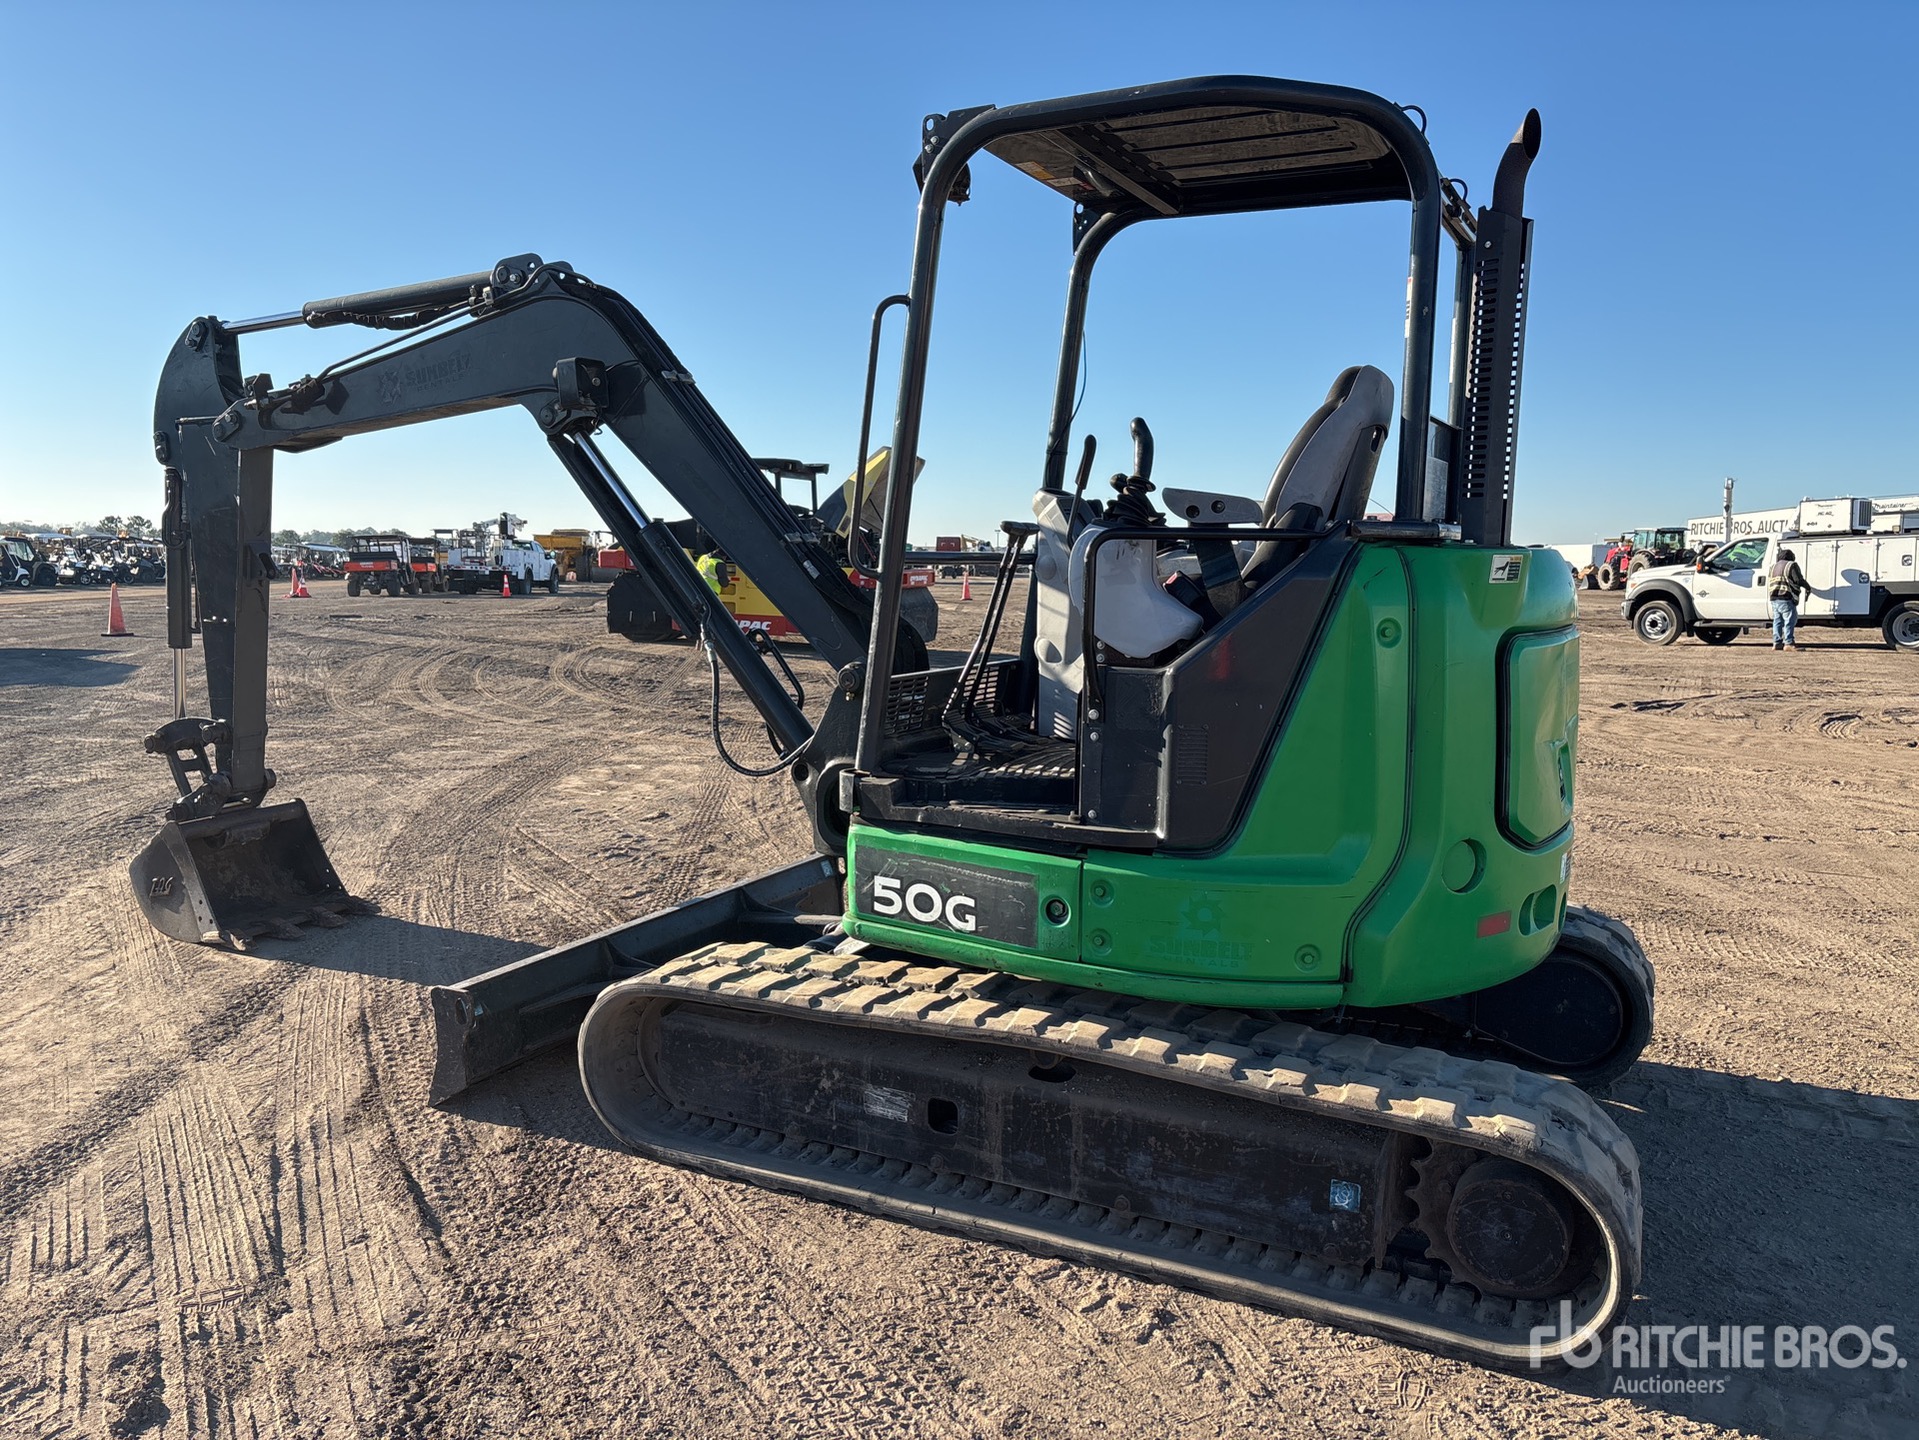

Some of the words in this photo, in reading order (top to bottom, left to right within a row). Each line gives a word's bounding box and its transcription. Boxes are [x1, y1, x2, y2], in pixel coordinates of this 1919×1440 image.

[1690, 521, 1725, 536] RITCHIE
[734, 620, 772, 632] PAC
[873, 875, 976, 931] 50G
[1150, 935, 1255, 961] SUNBELT
